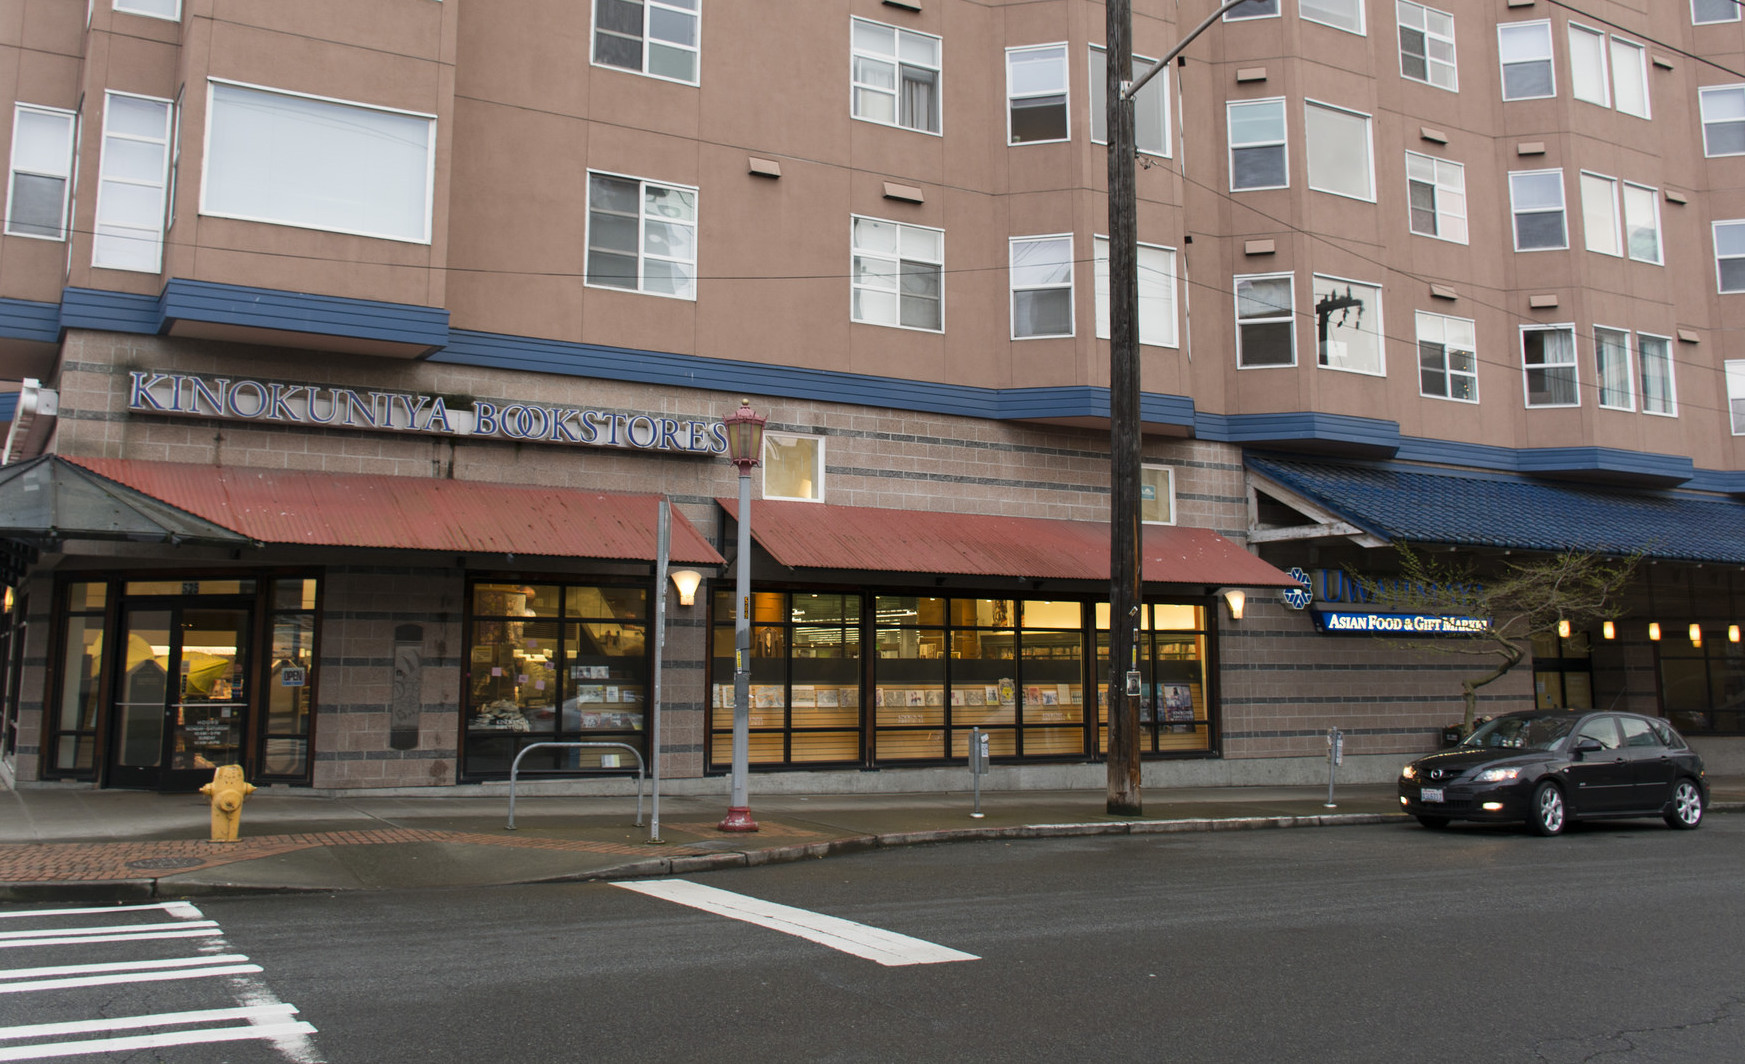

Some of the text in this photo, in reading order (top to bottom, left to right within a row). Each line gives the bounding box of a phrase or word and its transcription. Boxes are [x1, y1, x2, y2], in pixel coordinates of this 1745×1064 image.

[129, 371, 729, 453] KINOKUNIYA BOOKSTORES
[1329, 614, 1367, 630] ASIAN
[1368, 615, 1403, 630] FOOD
[1404, 618, 1414, 631] &
[1414, 616, 1442, 632] GIFT
[284, 670, 303, 681] OPEN
